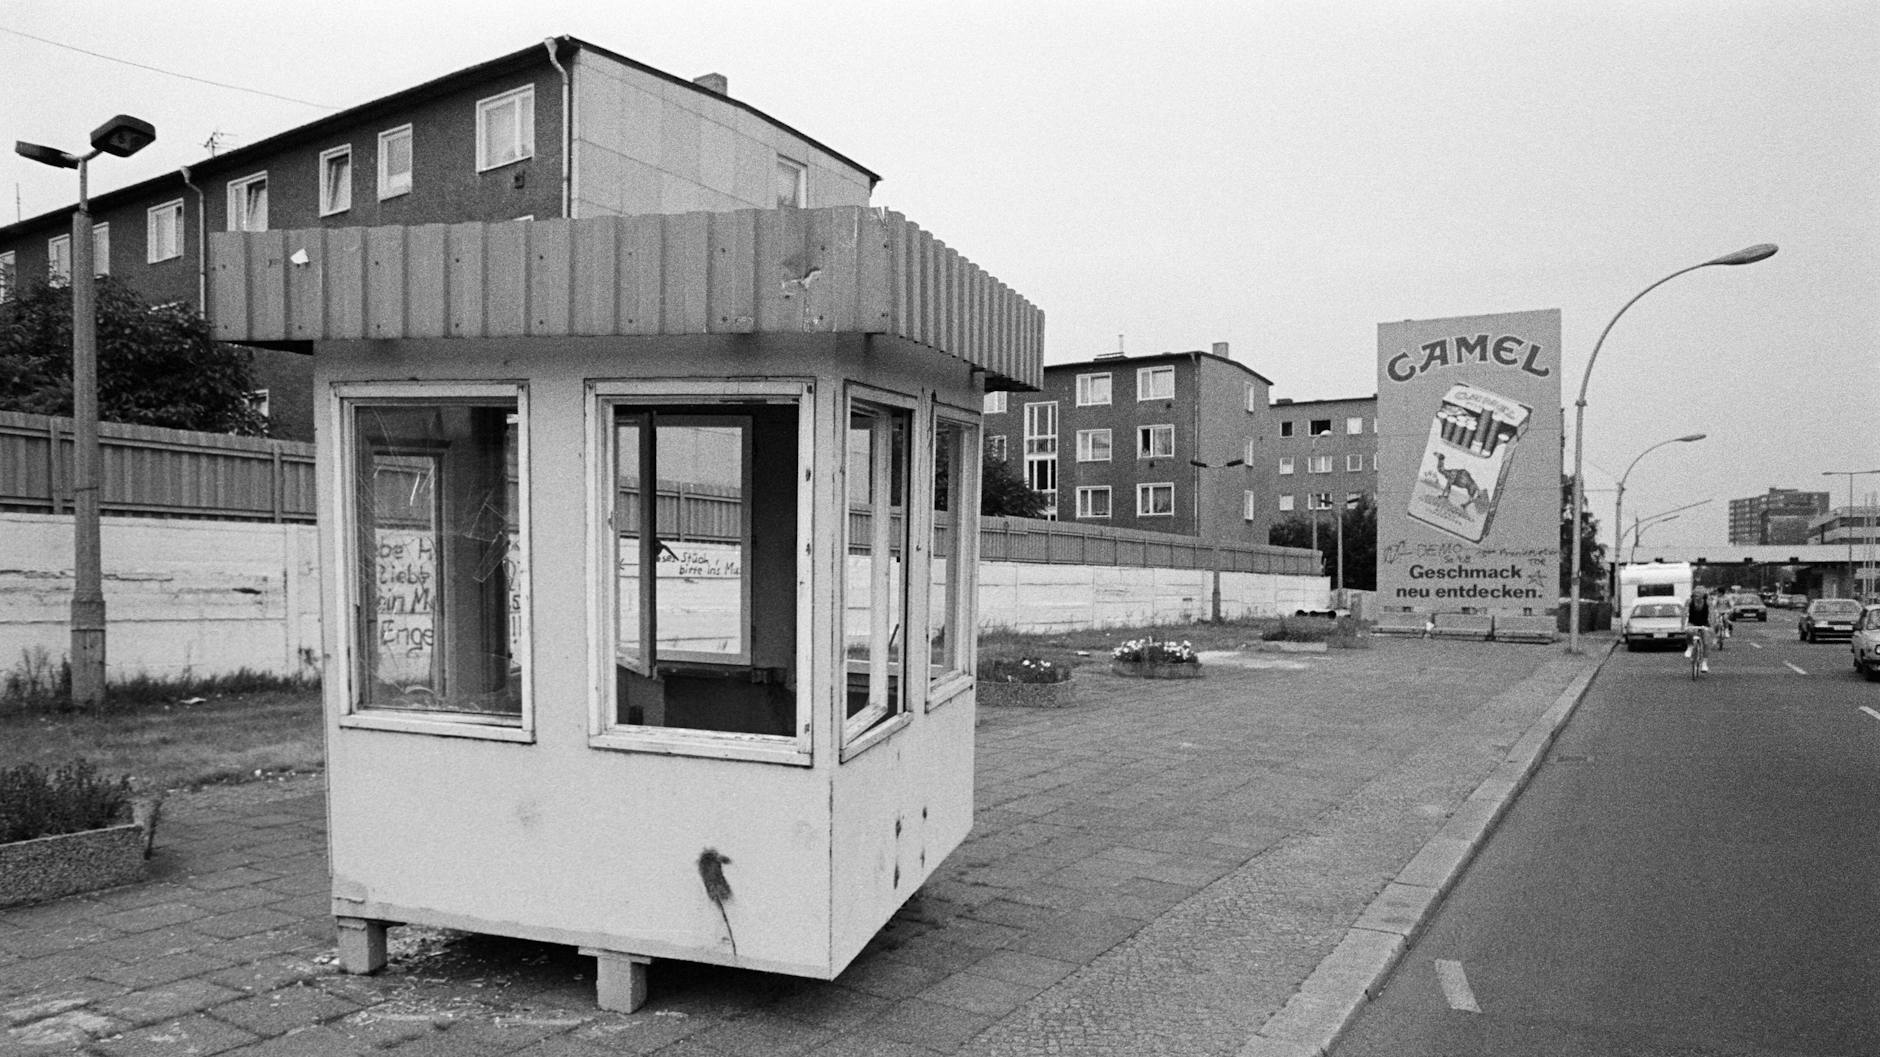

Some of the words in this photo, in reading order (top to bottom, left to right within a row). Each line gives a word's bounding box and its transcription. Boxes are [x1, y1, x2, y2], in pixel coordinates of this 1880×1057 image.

[1387, 334, 1550, 382] CAMEL
[1409, 564, 1522, 580] Geschmack
[1396, 587, 1430, 599] neu
[1435, 584, 1544, 599] entdecken.
